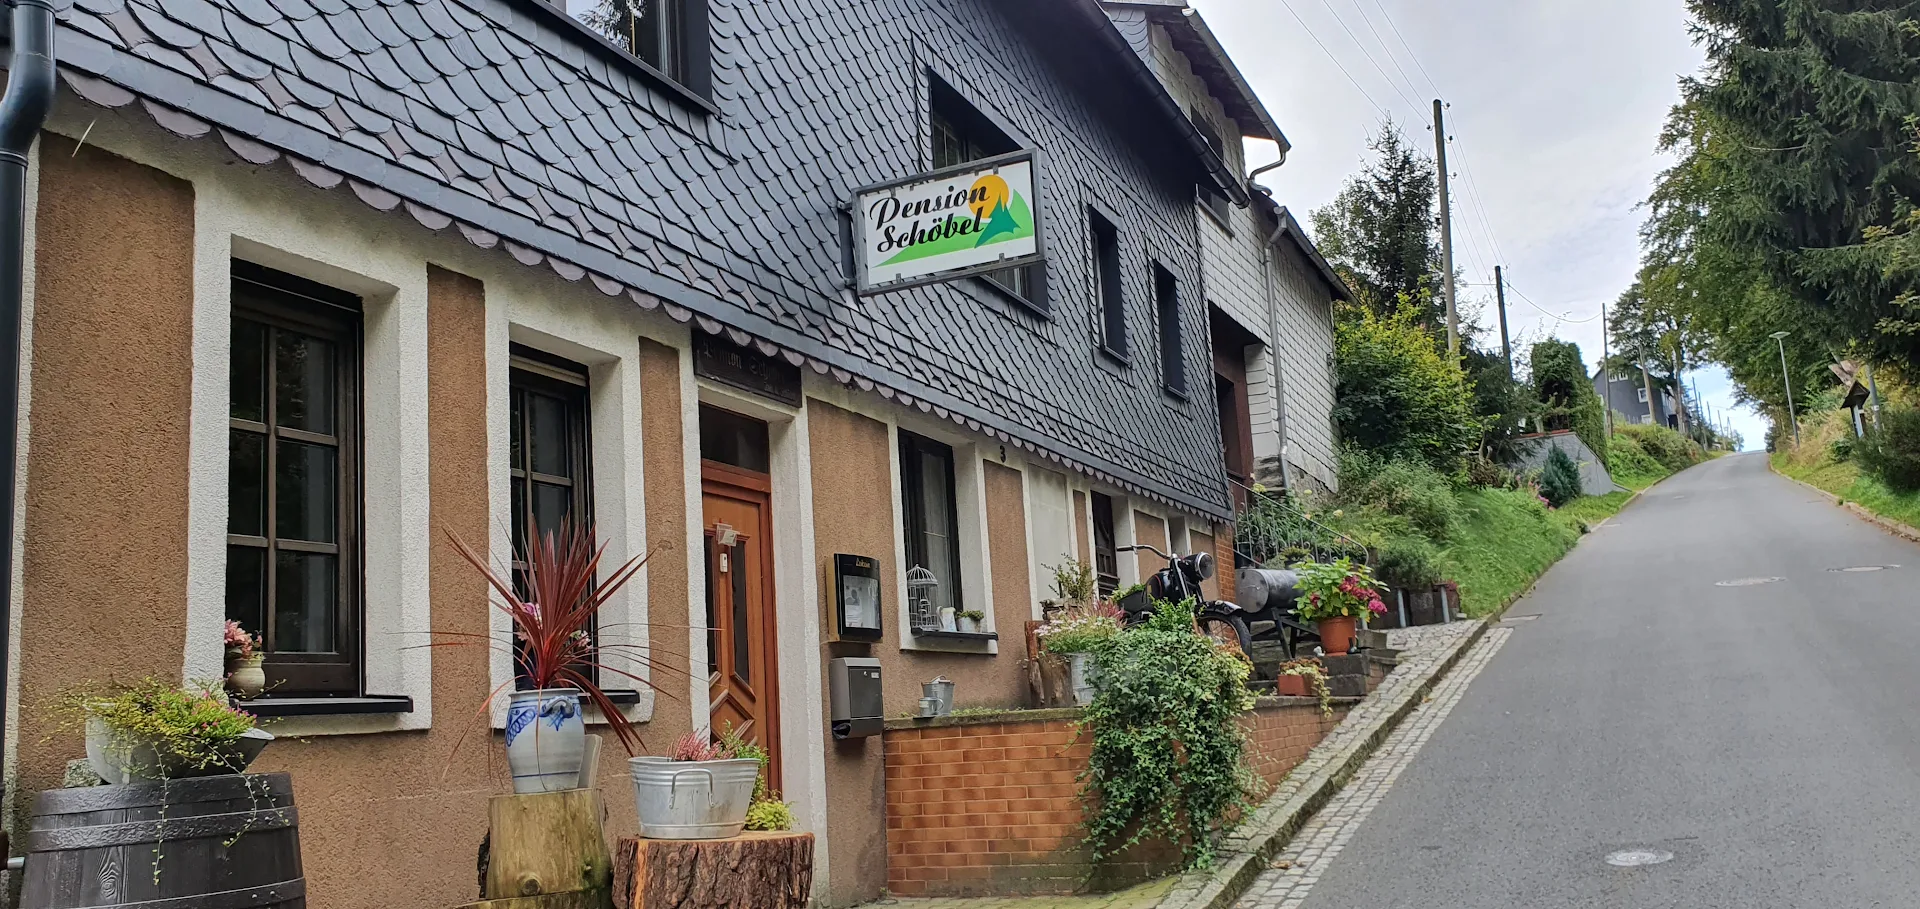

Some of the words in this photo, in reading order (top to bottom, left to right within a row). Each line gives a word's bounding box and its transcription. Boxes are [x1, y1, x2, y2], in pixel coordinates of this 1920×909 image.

[869, 185, 991, 231] Pension
[877, 207, 985, 253] Schöbel
[999, 444, 1007, 463] 3
